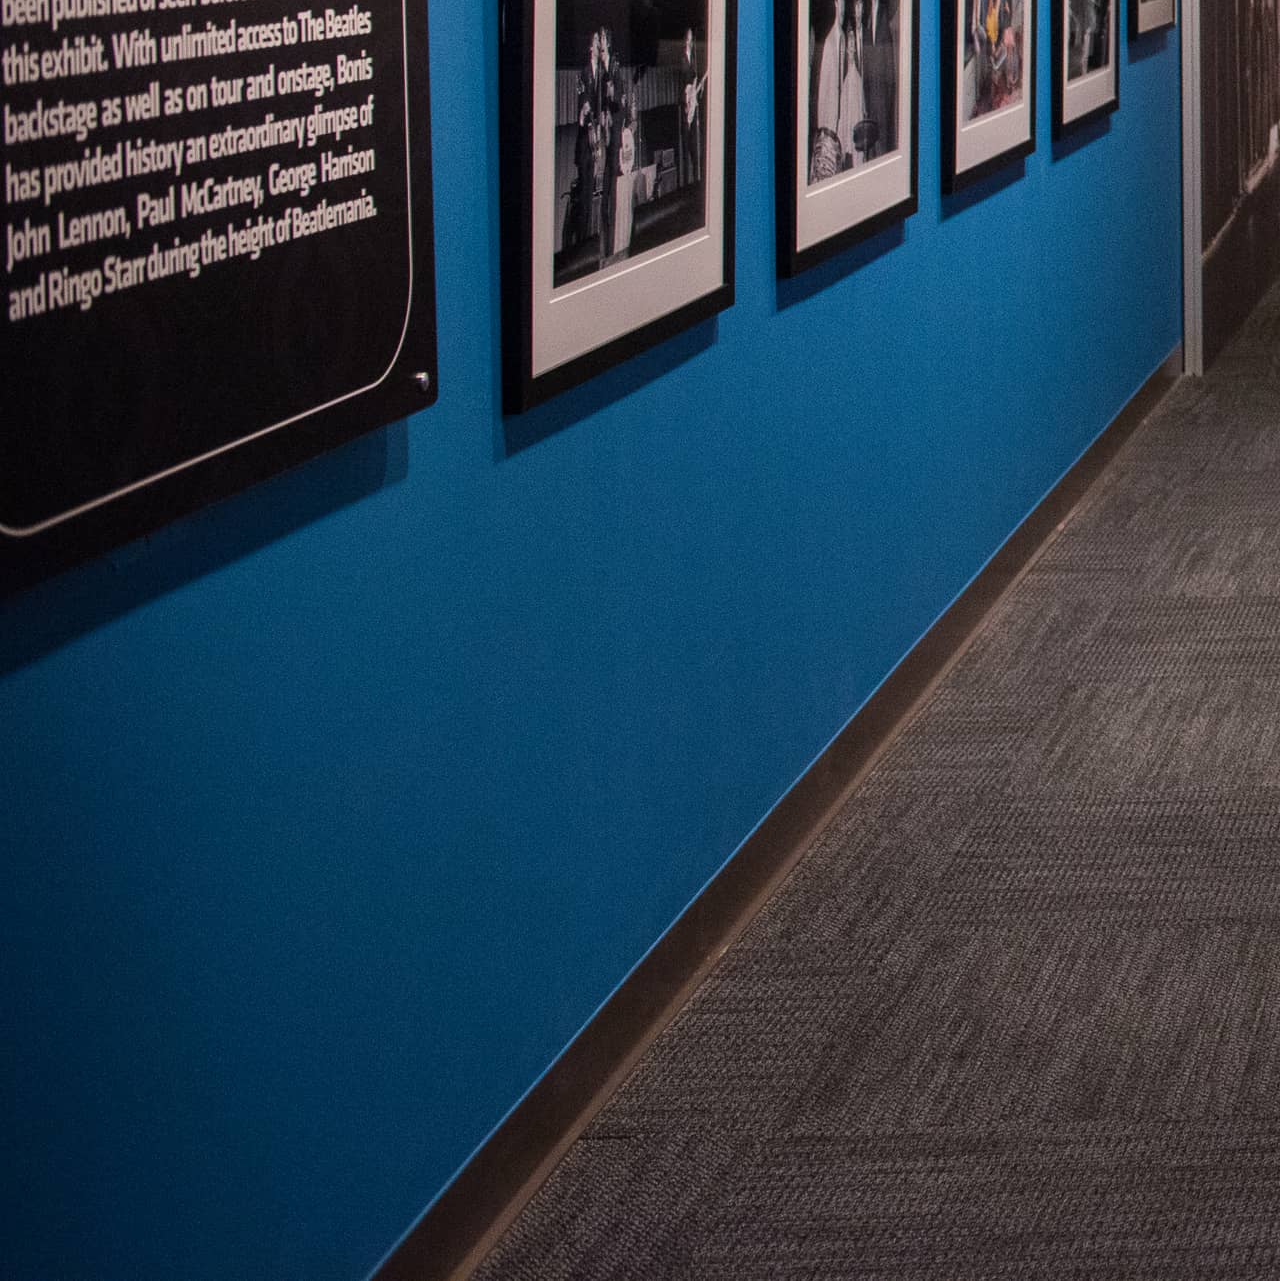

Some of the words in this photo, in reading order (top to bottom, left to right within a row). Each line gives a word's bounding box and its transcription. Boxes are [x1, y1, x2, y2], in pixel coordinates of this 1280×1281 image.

[4, 43, 38, 85] this
[42, 35, 107, 79] exhibit.
[113, 29, 156, 68] With
[162, 19, 235, 62] unlimited
[238, 23, 282, 51] access
[283, 17, 297, 45] to
[299, 10, 324, 42] The
[326, 5, 371, 39] Beatles
[5, 100, 96, 144] backstage
[103, 98, 121, 126] as
[126, 82, 159, 121] well
[165, 88, 182, 115] as
[187, 84, 207, 111] on
[211, 77, 243, 107] tour
[247, 64, 274, 100] and
[278, 63, 334, 97] onstage,
[337, 50, 372, 84] Bonis
[7, 164, 40, 203] has
[45, 143, 122, 205] provided
[127, 138, 183, 176] history
[187, 136, 206, 163] an
[209, 114, 305, 158] extraordinary
[307, 104, 358, 146] glimpse
[360, 95, 373, 126] of
[8, 219, 50, 271] John
[59, 207, 130, 248] Lennon,
[138, 186, 174, 228] Paul
[182, 175, 263, 217] McCartney,
[269, 163, 316, 196] George
[322, 145, 374, 182] Harrison
[11, 273, 44, 321] and
[50, 267, 101, 310] Ringo
[105, 256, 145, 293] Starr
[148, 237, 198, 280] during
[201, 229, 226, 264] the
[229, 216, 274, 259] height
[276, 208, 291, 243] of
[293, 189, 376, 238] Beatlemania.
